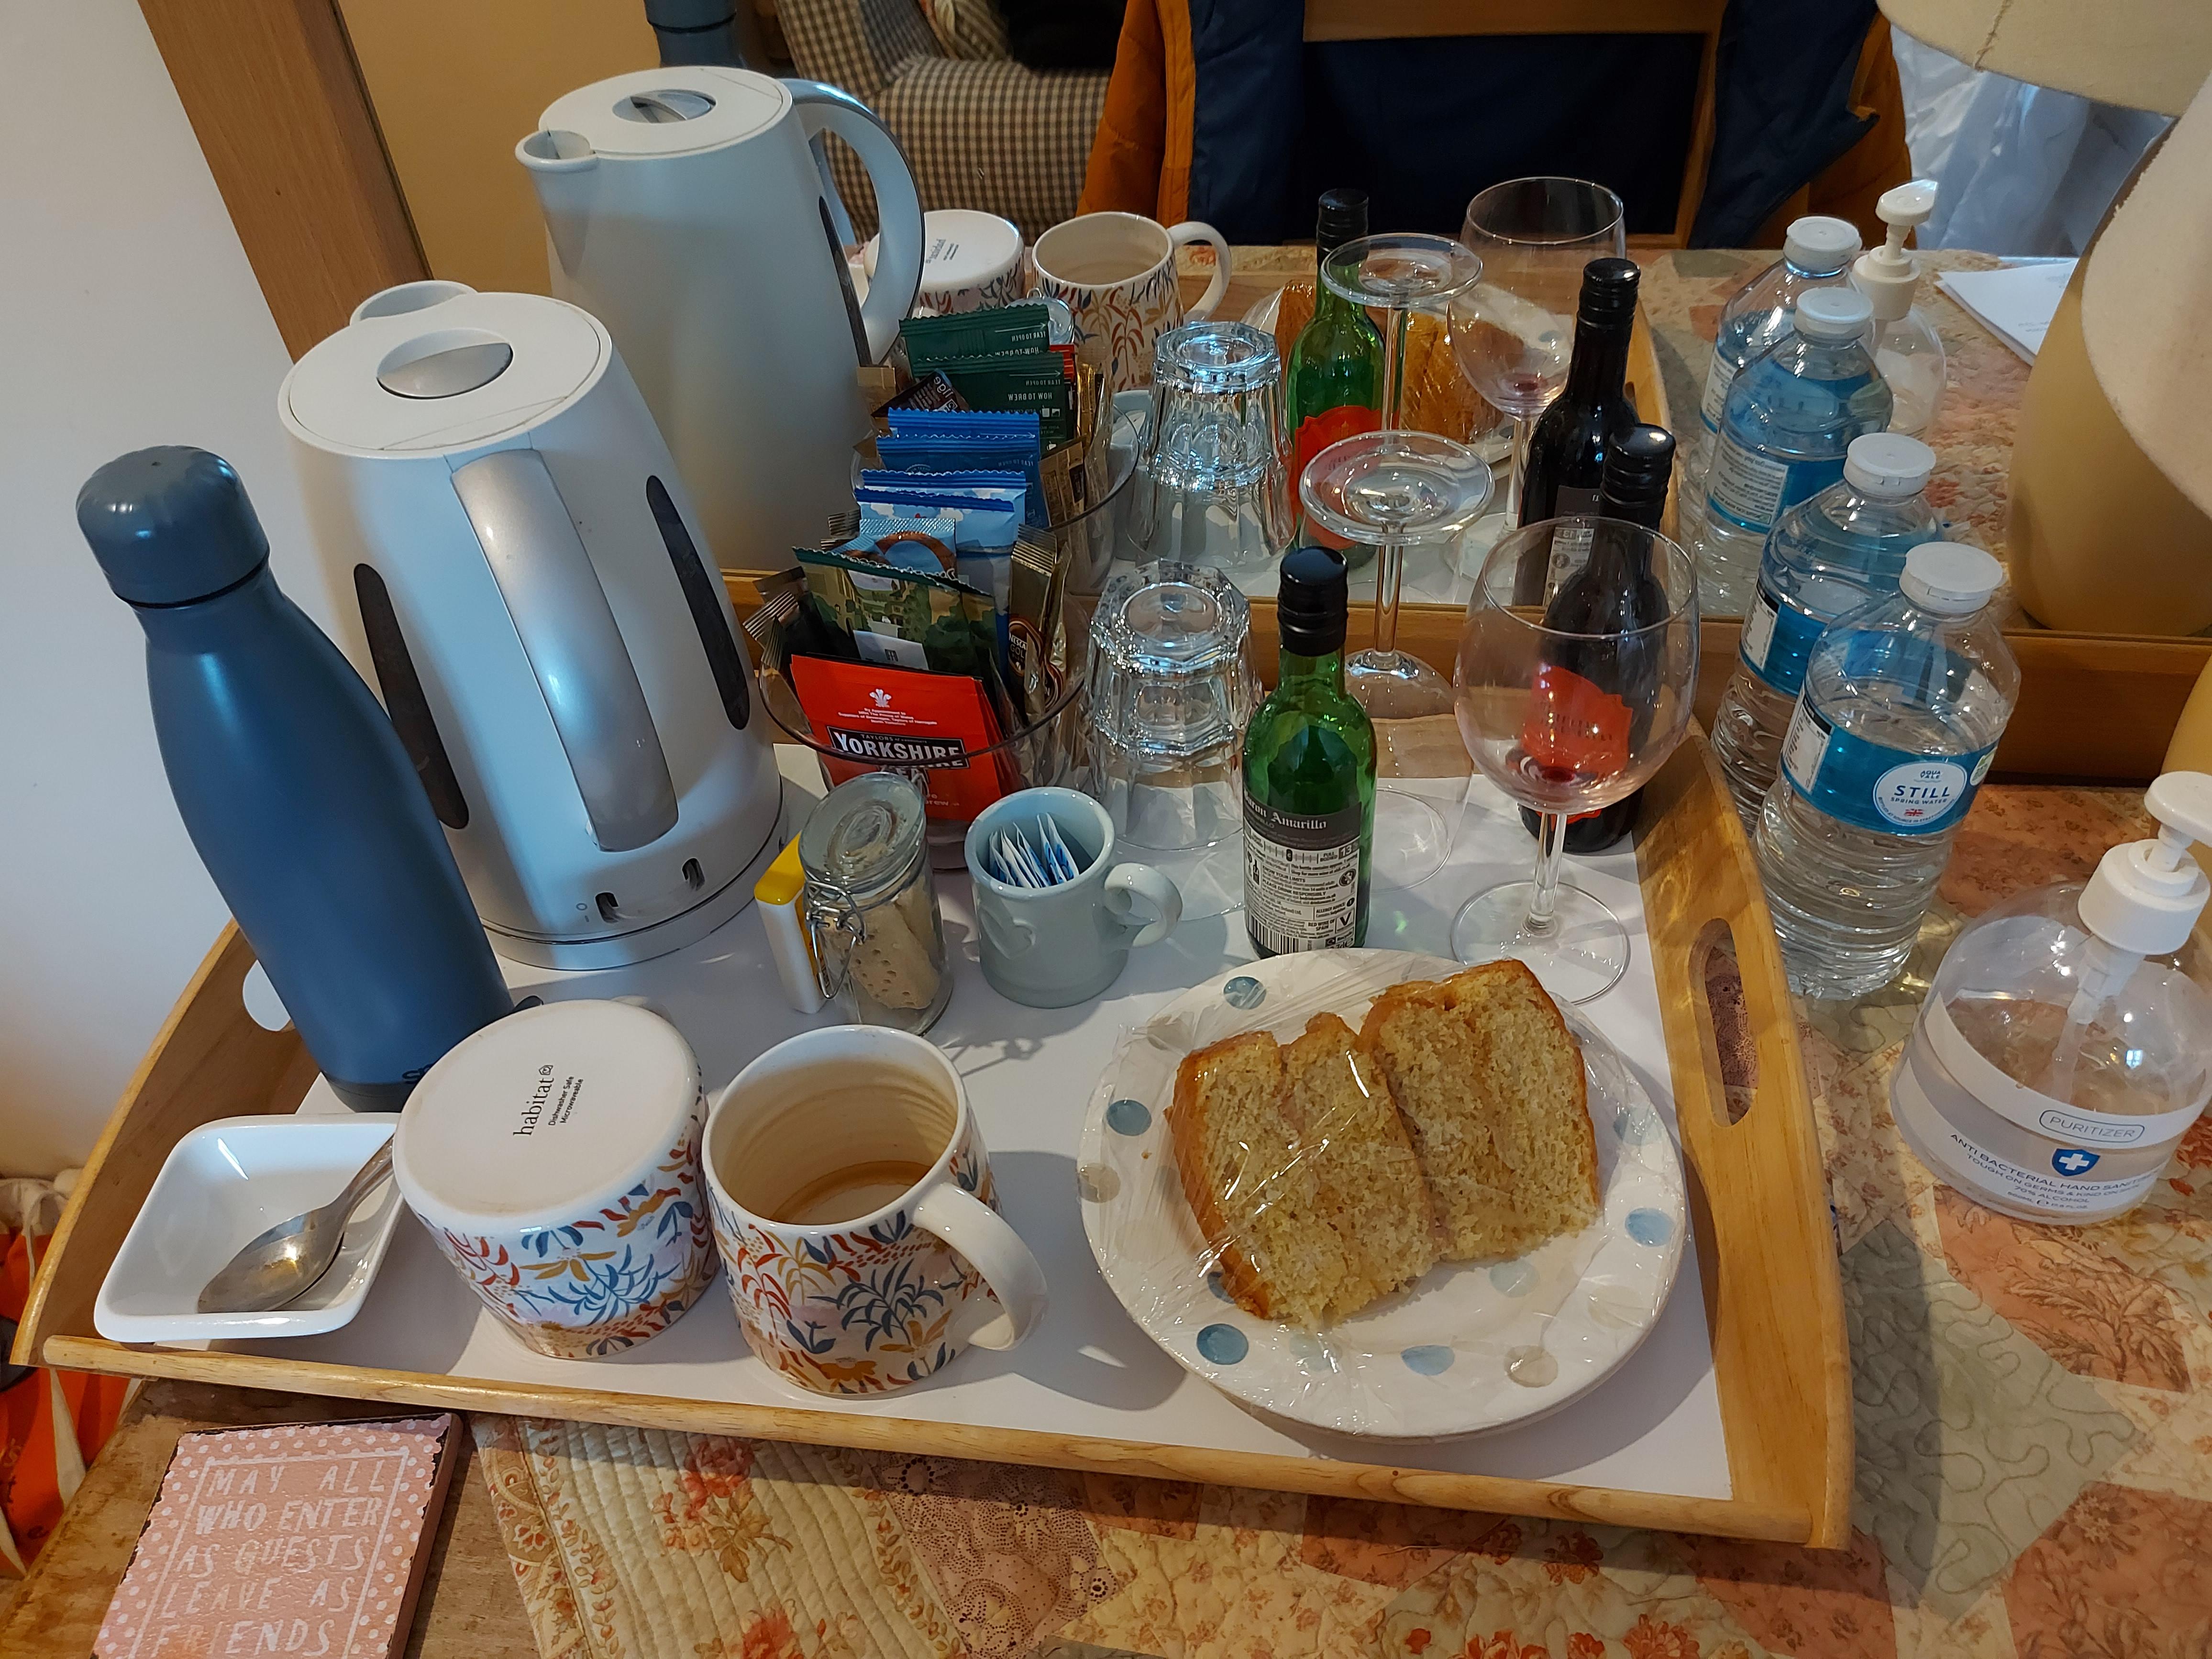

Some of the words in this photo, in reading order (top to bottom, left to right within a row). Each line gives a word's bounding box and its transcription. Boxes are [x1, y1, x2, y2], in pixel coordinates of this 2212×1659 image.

[1009, 632, 1027, 650] NESCA
[1010, 644, 1025, 659] GOL
[833, 731, 960, 763] YORKSHIRE
[861, 734, 893, 742] TAYLORS
[1894, 785, 1950, 798] STILL
[1271, 812, 1327, 830] Amarillo
[513, 1077, 554, 1136] habitat
[548, 1090, 568, 1126] Dishwasher
[563, 1076, 574, 1089] Safe
[559, 1078, 584, 1124] Microwaveable
[2049, 1116, 2135, 1137] PURITIZER
[1950, 1134, 1978, 1154] ANTI
[1980, 1153, 2056, 1187] BACTERIAL
[1967, 1153, 2003, 1177] TOUGH
[2005, 1175, 2022, 1184] ON
[2024, 1182, 2064, 1195] GERMS
[2014, 1185, 2036, 1195] 70%
[2038, 1194, 2090, 1202] ALCOHOL
[206, 1465, 285, 1497] MAY
[319, 1460, 385, 1494] ALL
[195, 1500, 267, 1535] WHO
[278, 1497, 383, 1533] ENTER
[175, 1543, 221, 1578] AS
[235, 1534, 369, 1576] GUESTS
[159, 1576, 282, 1619] LEAVE
[308, 1576, 355, 1612] AS
[150, 1618, 335, 1658] FRIENDS
